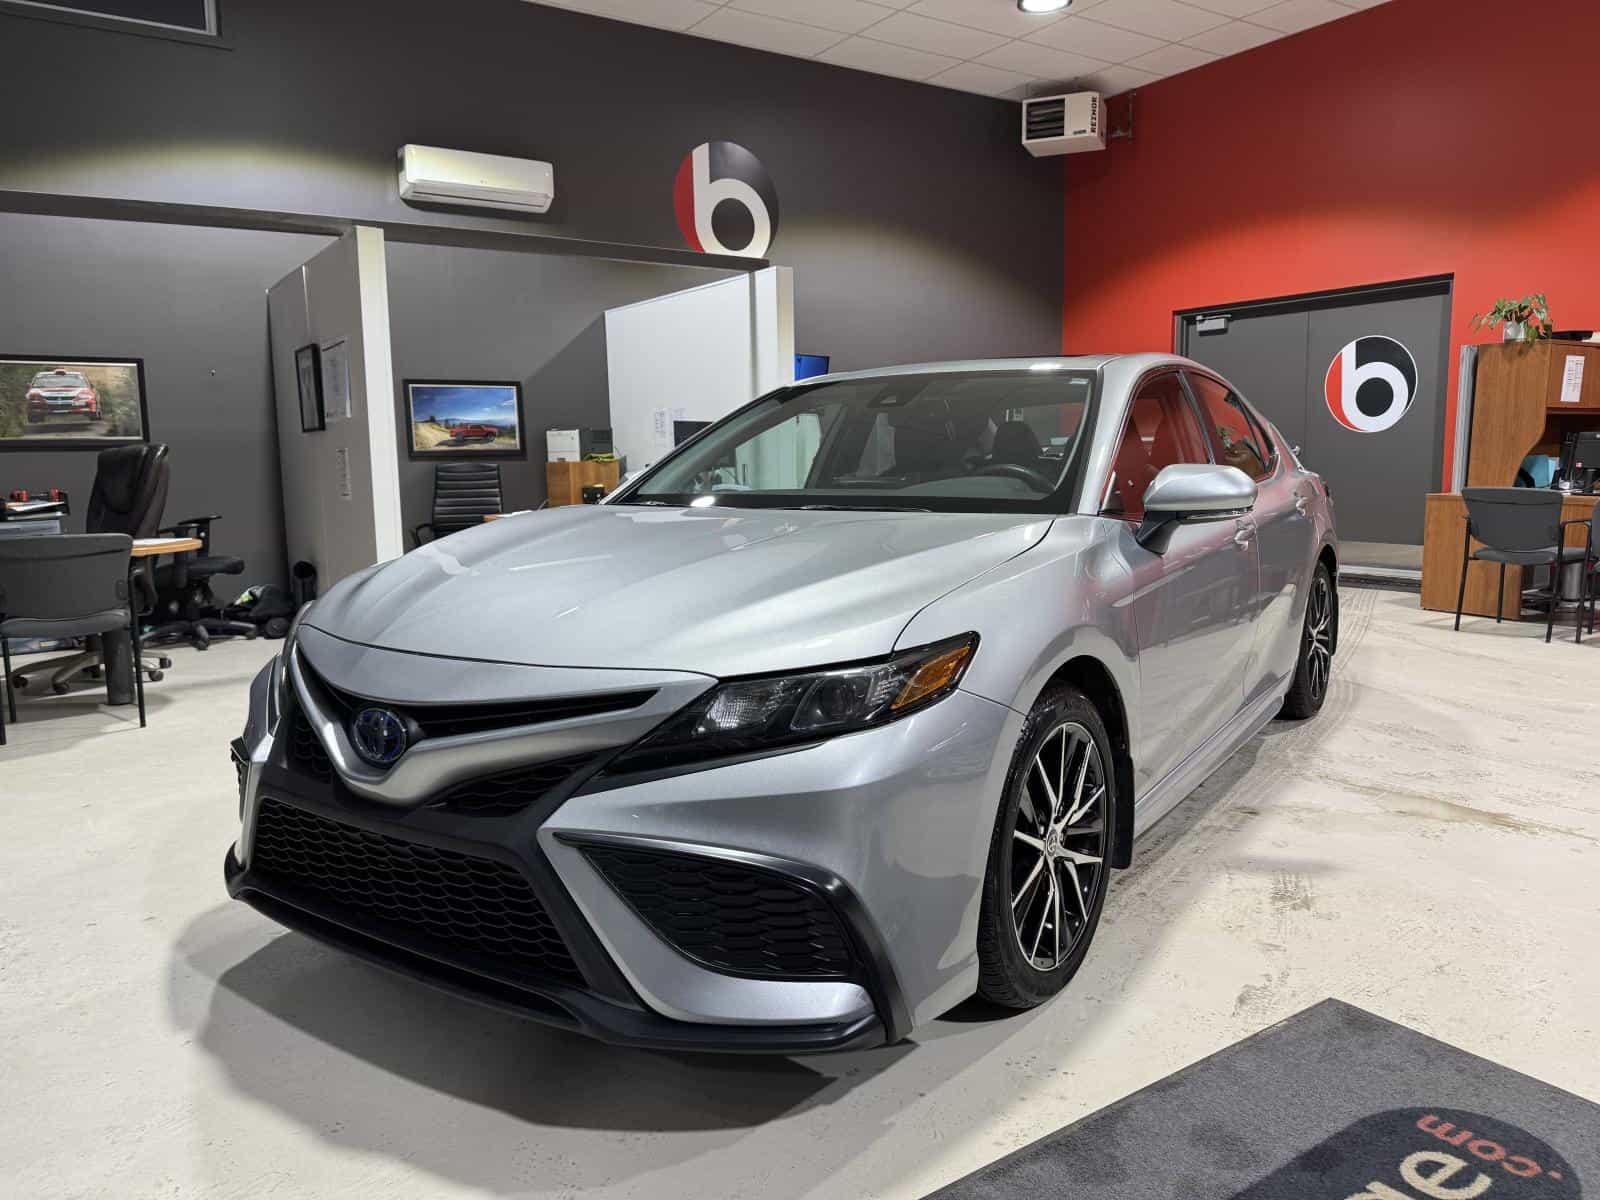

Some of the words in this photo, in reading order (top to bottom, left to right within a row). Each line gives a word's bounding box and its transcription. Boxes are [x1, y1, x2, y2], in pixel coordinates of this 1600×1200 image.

[692, 142, 771, 259] b
[1341, 340, 1409, 433] b
[1416, 1114, 1563, 1180] .com
